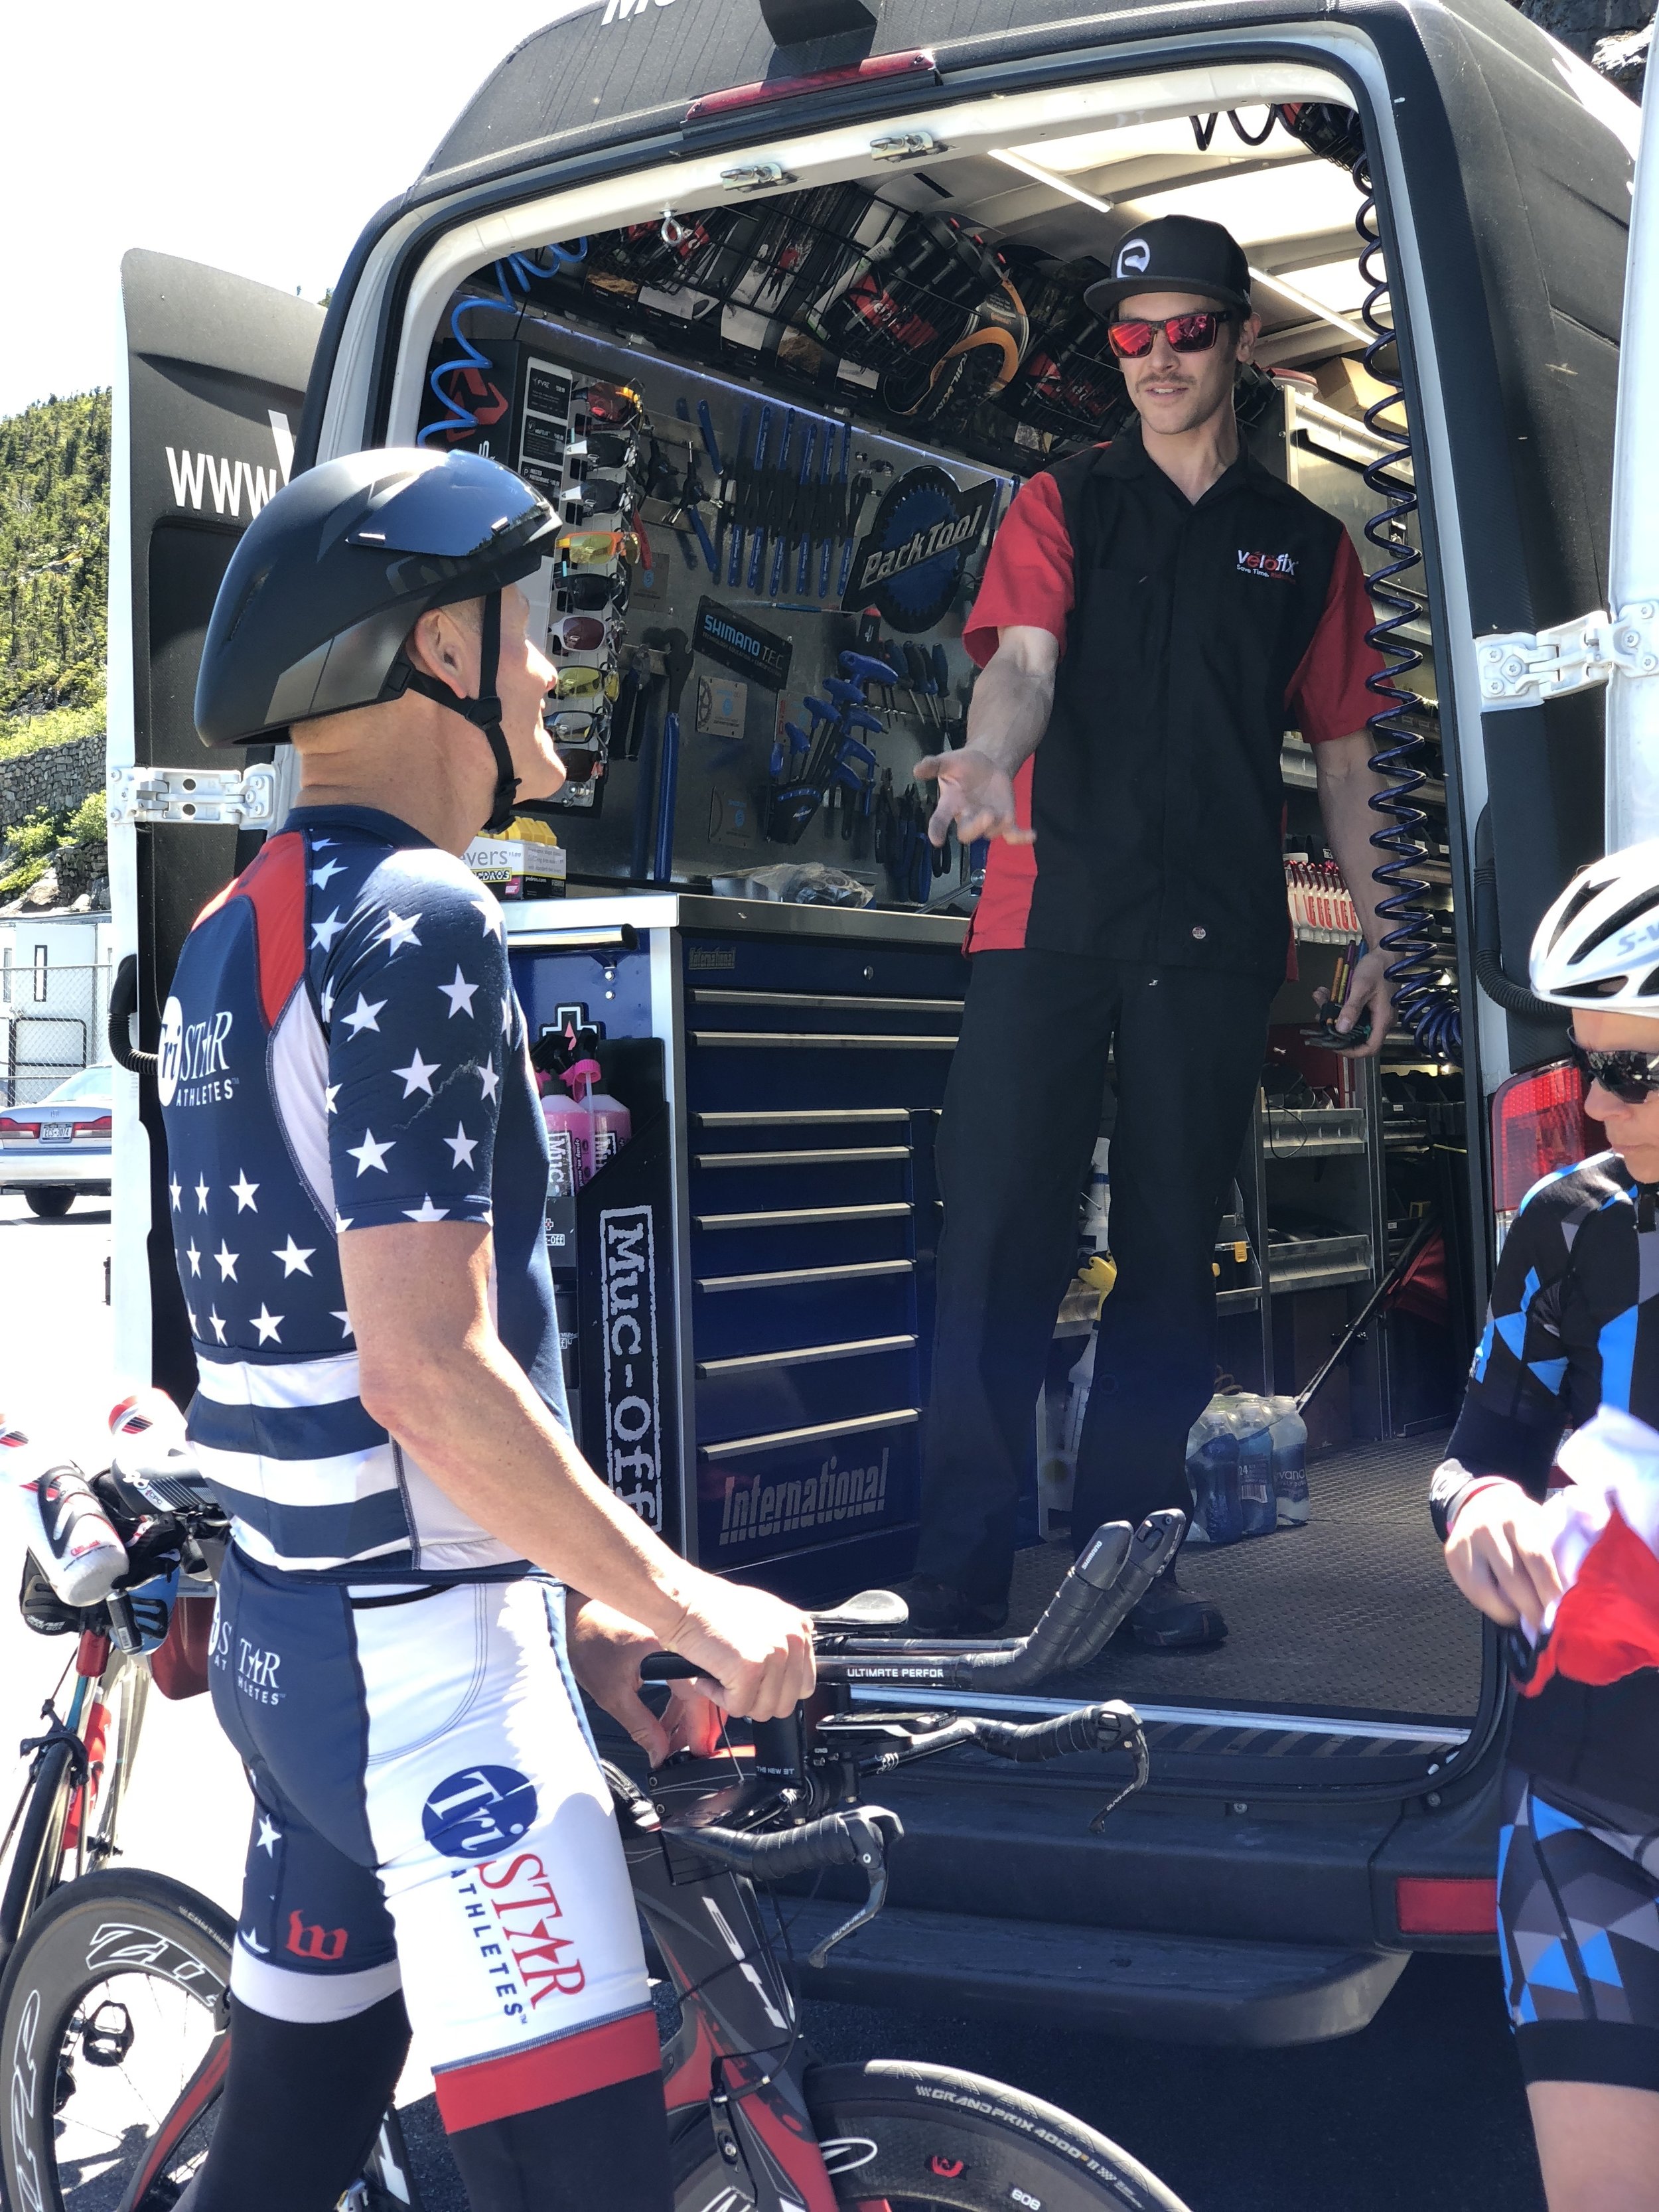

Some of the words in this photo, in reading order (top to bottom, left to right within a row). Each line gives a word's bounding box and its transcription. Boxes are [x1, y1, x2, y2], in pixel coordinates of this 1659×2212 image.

[703, 615, 761, 657] SHIMANO
[176, 1078, 234, 1107] ATHLETES
[607, 1222, 657, 1521] Muc-Off
[719, 1447, 890, 1546] International
[1081, 1540, 1103, 1570] SHIMANO
[847, 1668, 899, 1678] ULTIMATE
[931, 2088, 993, 2114] GRAND
[991, 2108, 1035, 2132] PRIX
[1034, 2127, 1083, 2158] 4000
[1010, 2187, 1041, 2212] 808
